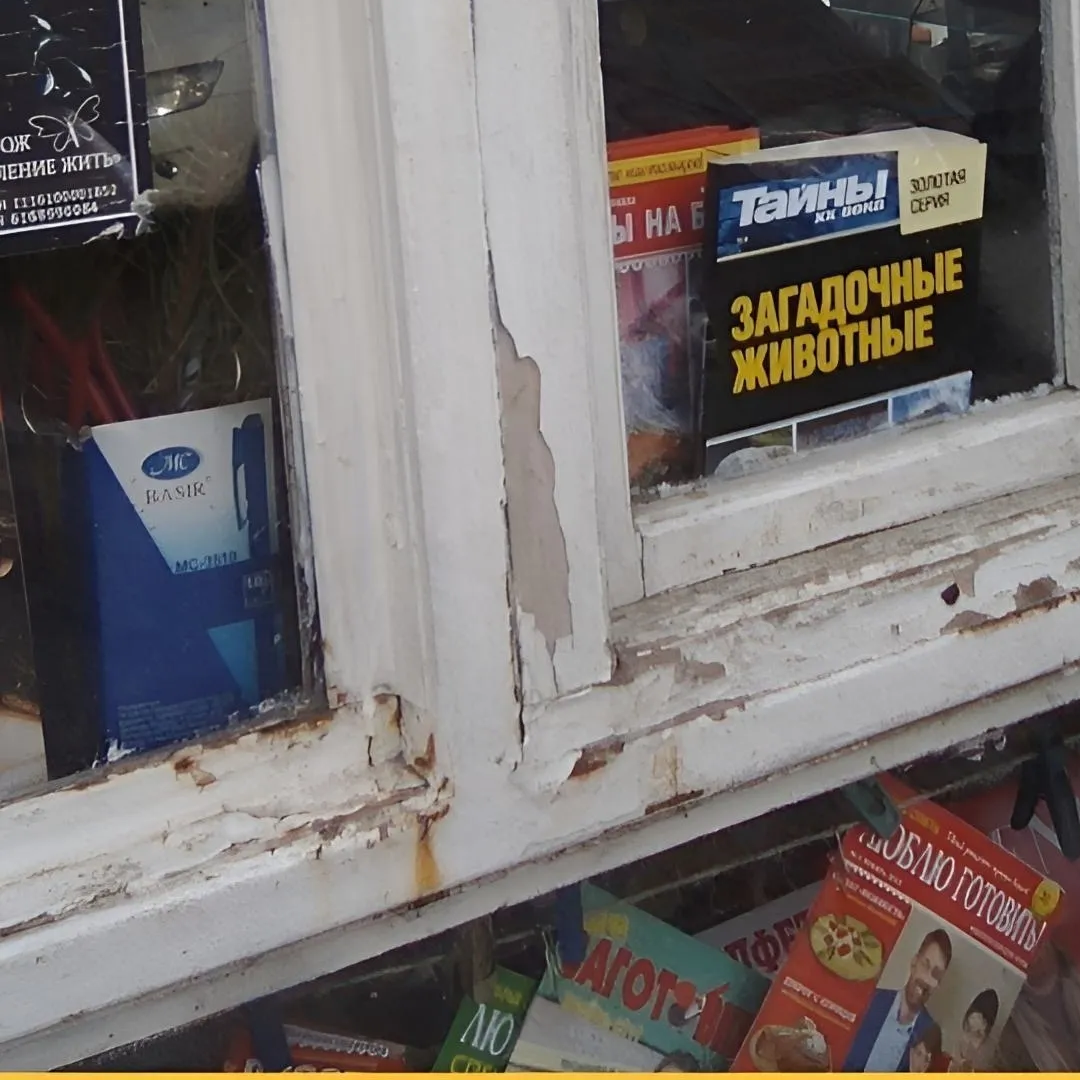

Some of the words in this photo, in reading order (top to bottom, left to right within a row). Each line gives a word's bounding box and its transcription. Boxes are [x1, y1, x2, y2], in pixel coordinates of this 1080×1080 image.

[731, 170, 889, 228] Тайны
[909, 168, 967, 195] ЗОЛОТАЯ
[910, 192, 950, 215] СЕРИЯ
[646, 205, 682, 239] НА
[730, 247, 963, 342] ЗАГАДОЧНЫЕ
[732, 304, 934, 395] ЖИВОТНЫЕ
[858, 824, 955, 891] ЮБЛЮ
